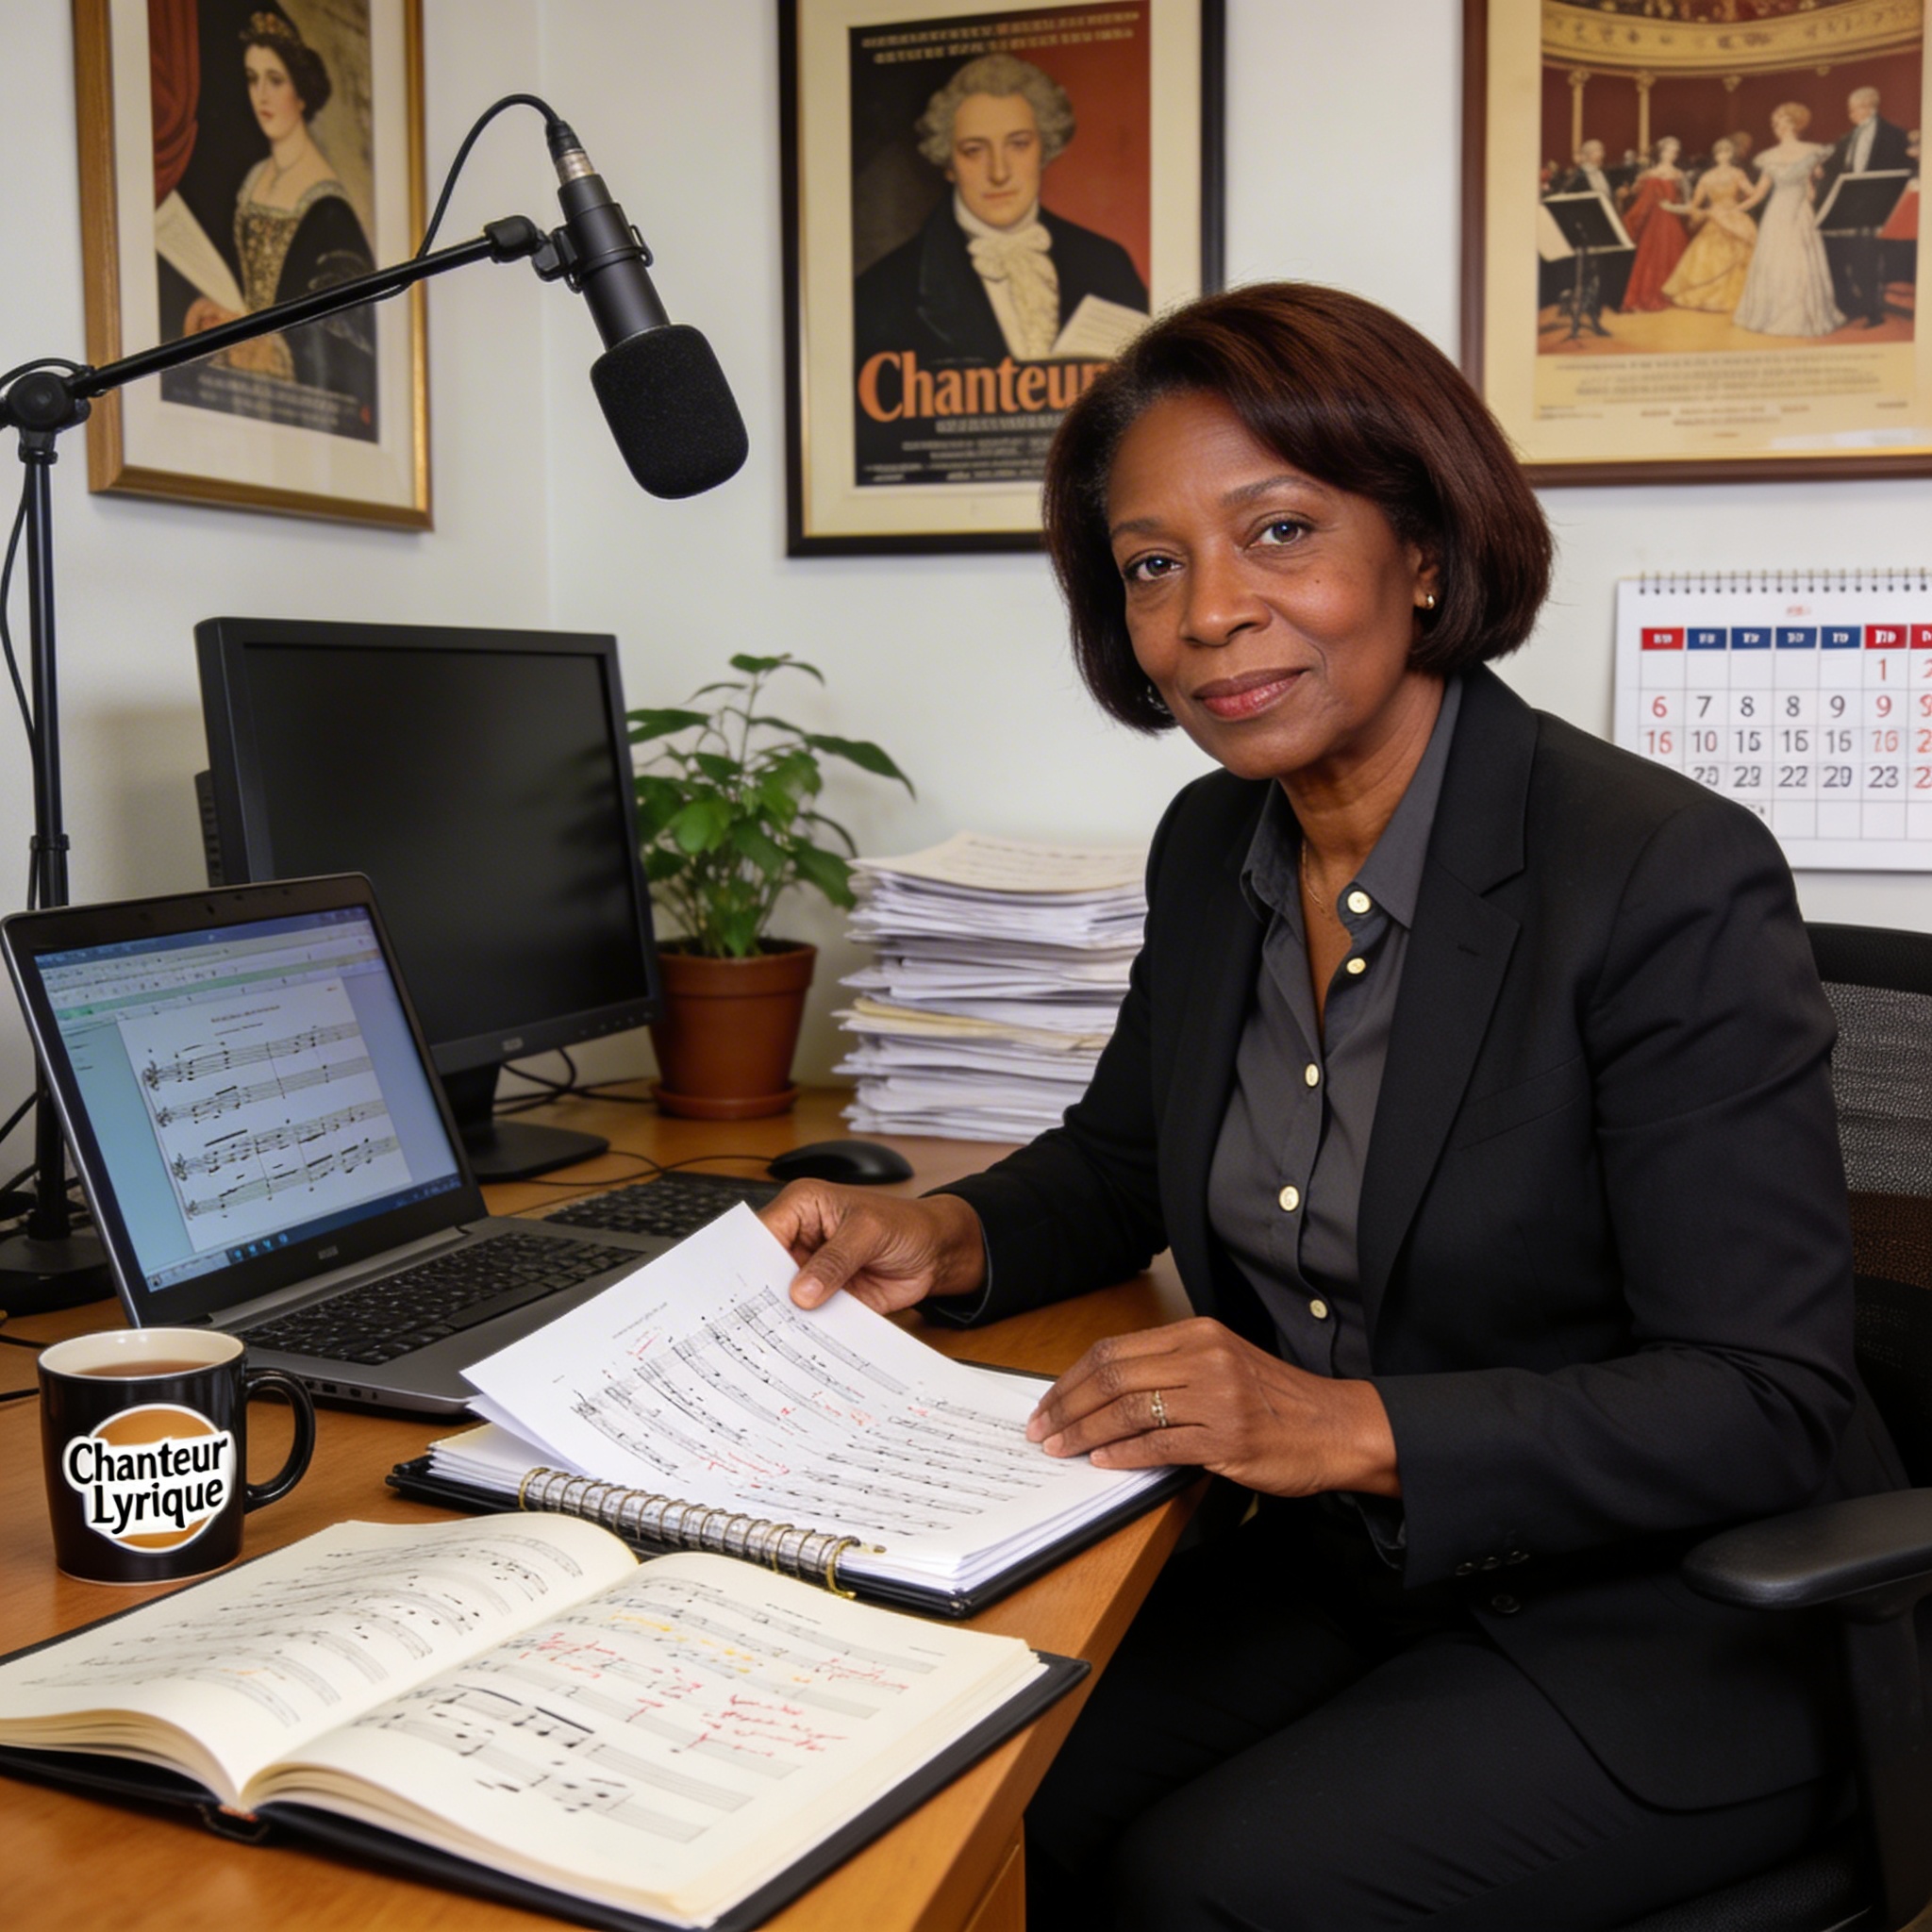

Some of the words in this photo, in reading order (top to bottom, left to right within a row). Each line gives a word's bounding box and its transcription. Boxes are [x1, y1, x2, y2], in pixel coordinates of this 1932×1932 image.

[1878, 657, 1887, 681] 1
[1652, 695, 1667, 718] 6
[1696, 695, 1712, 718] 7
[1740, 695, 1755, 717] 8
[1786, 695, 1800, 717] 8
[1829, 695, 1845, 718] 9
[1876, 695, 1892, 718] 9
[1691, 729, 1717, 753] 10
[69, 1438, 227, 1485] Chanteur
[92, 1478, 224, 1535] Lyrique
